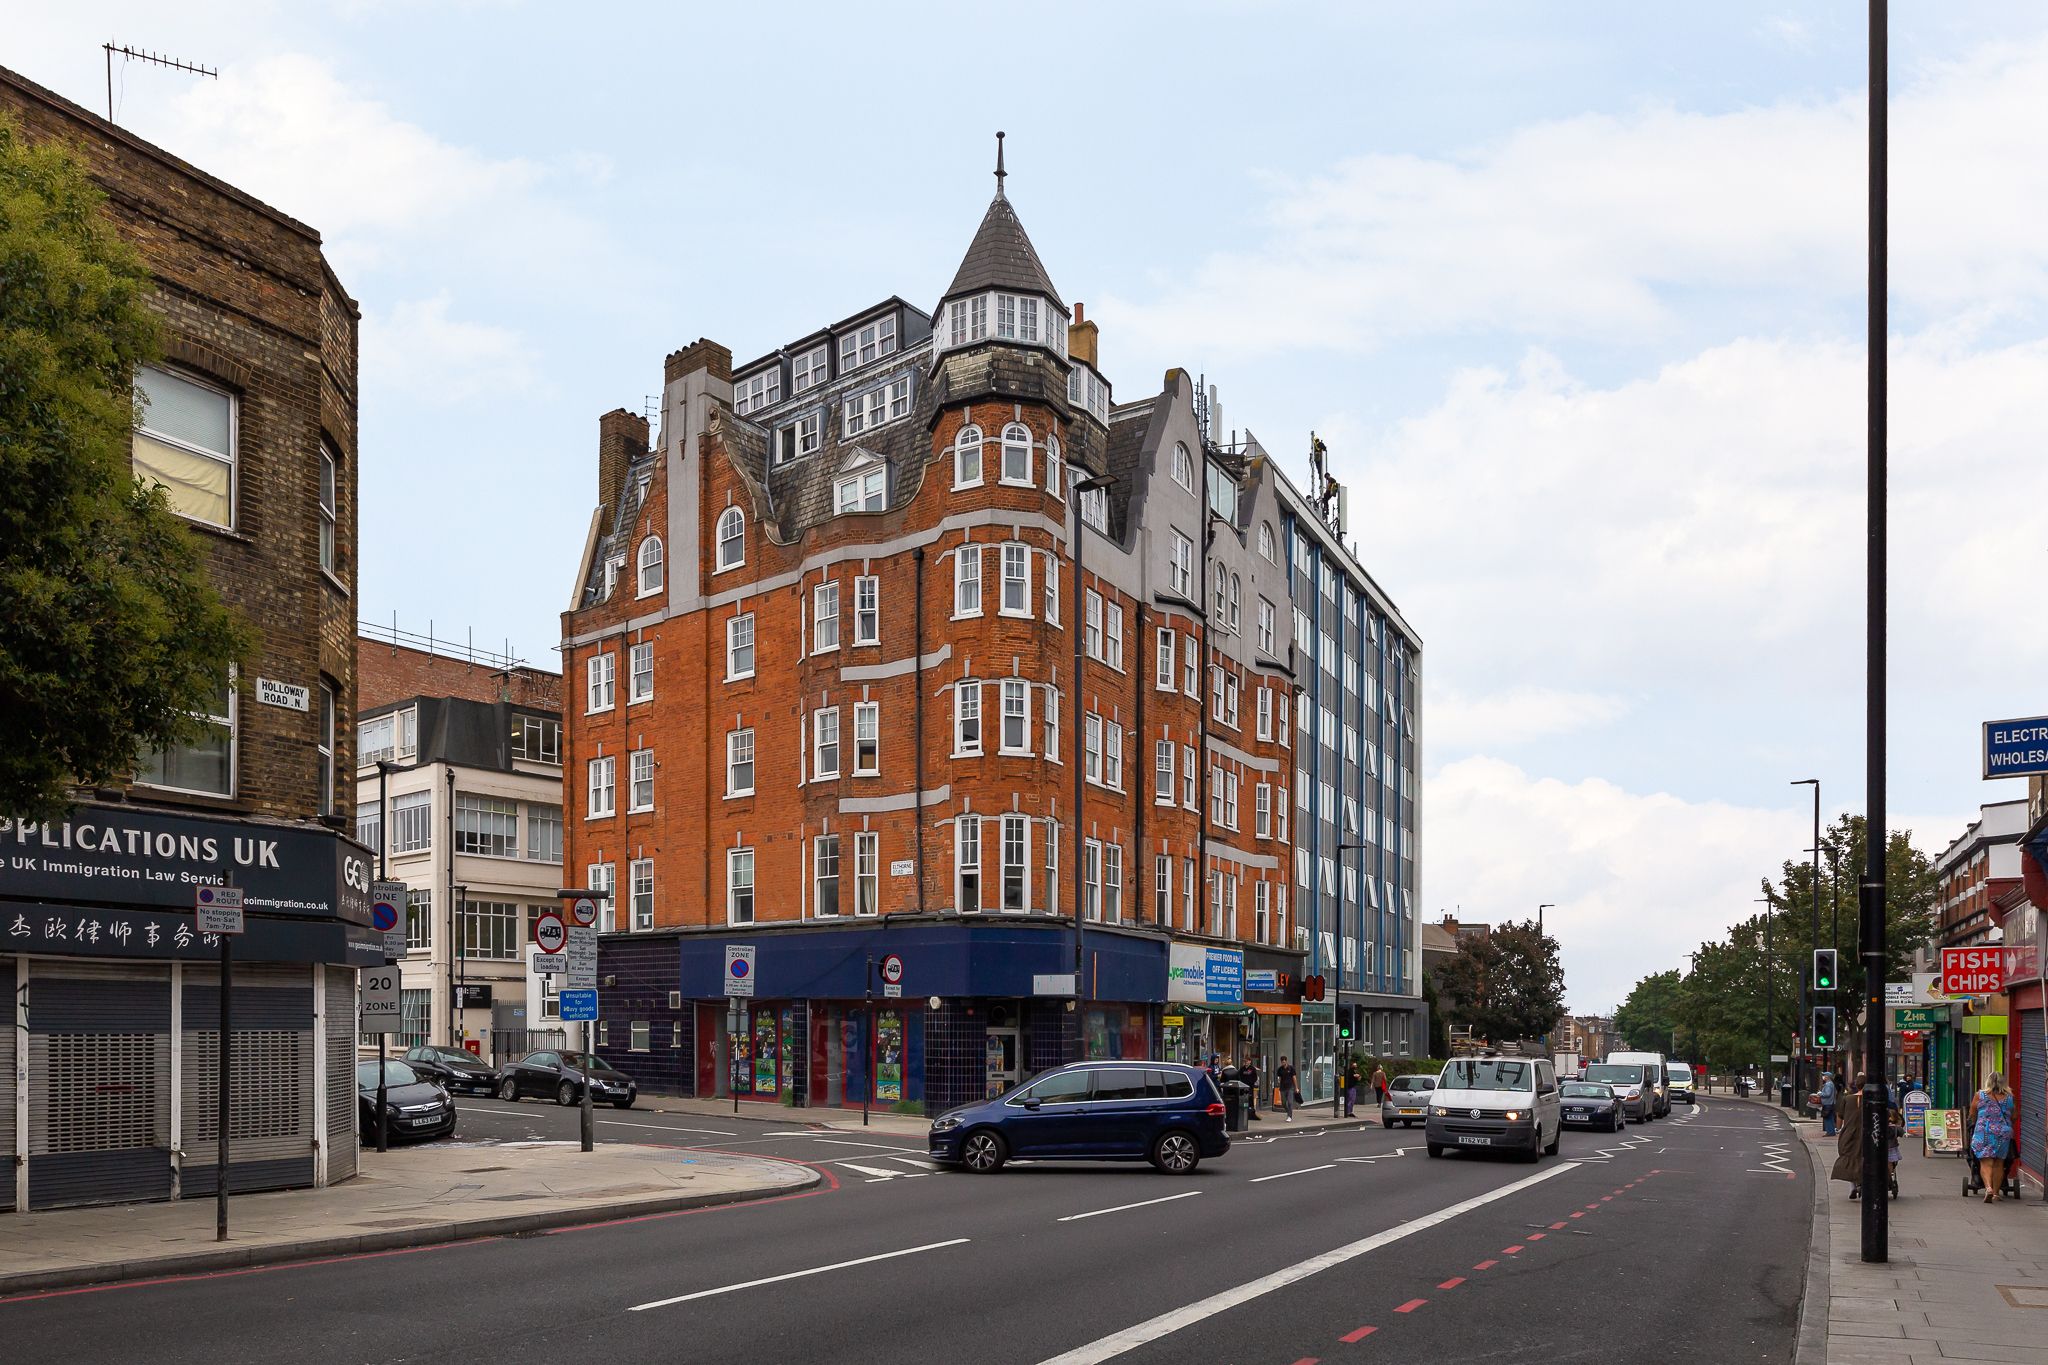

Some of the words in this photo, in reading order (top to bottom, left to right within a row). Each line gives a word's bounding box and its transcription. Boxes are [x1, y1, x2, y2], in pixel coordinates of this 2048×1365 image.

[262, 681, 304, 698] HOLLOWAY
[264, 692, 288, 705] ROAD
[1994, 727, 2048, 744] ELECTR
[234, 837, 280, 869] UK
[12, 857, 36, 871] UK
[43, 859, 140, 879] Immigration
[146, 868, 175, 882] Law
[181, 871, 224, 886] Servic
[373, 884, 404, 892] ntrolled
[374, 892, 398, 901] ONE
[243, 896, 329, 911] eoimmigration.co.uk
[212, 909, 241, 917] stopping
[536, 956, 555, 964] Except
[1946, 951, 2000, 969] FISH
[540, 963, 560, 971] loading
[369, 977, 392, 990] 20
[1947, 973, 2000, 991] CHIPS
[366, 1002, 396, 1011] ZONE
